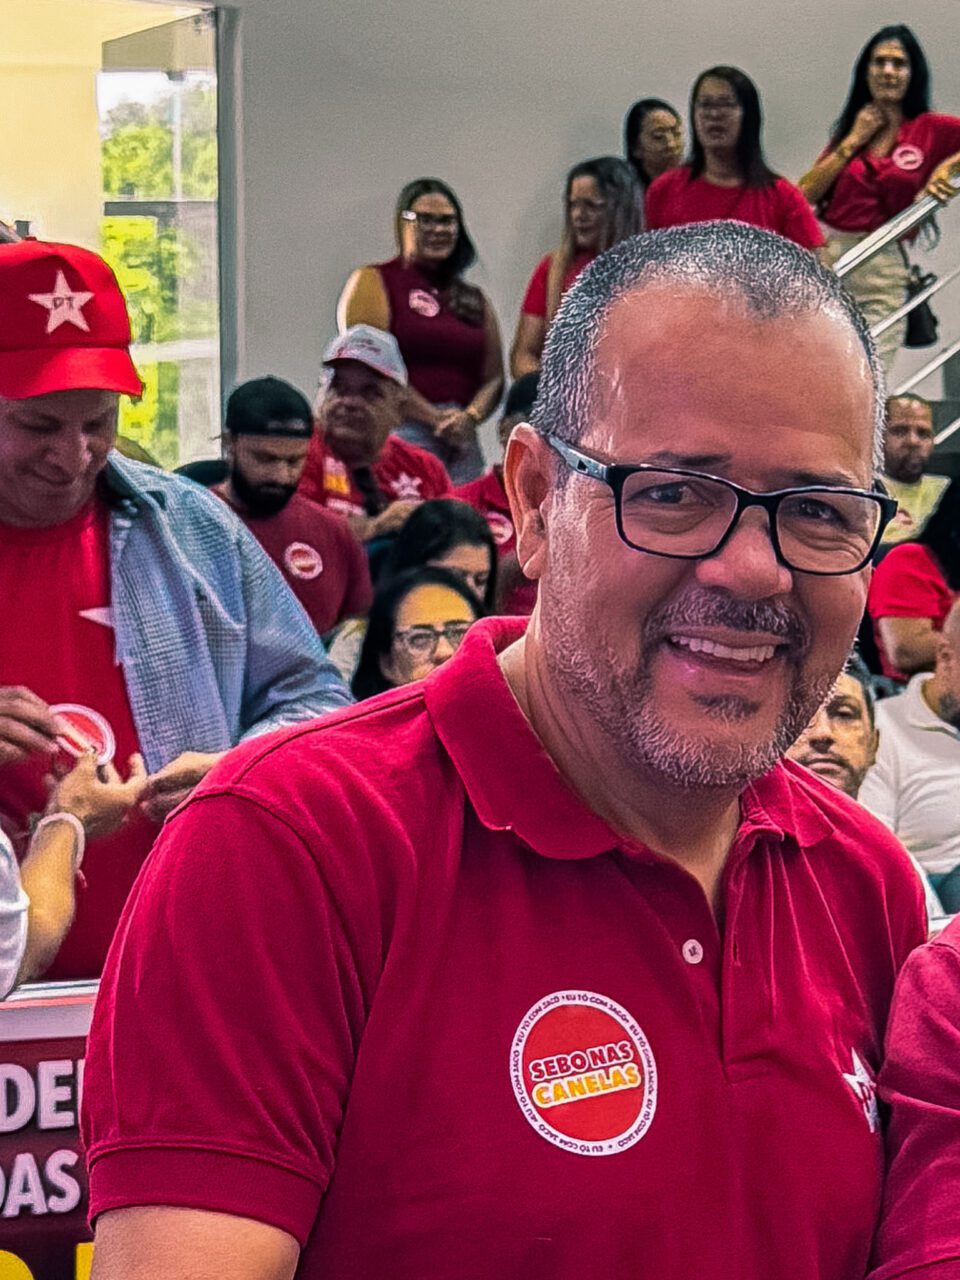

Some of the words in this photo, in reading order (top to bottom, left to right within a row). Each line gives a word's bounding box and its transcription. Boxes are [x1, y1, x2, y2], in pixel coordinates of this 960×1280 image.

[53, 296, 75, 311] PT
[531, 1052, 587, 1079] SEBO
[589, 1043, 632, 1067] NAS
[0, 1059, 85, 1132] DE
[534, 1065, 640, 1106] CANELAS
[0, 1149, 81, 1218] AS
